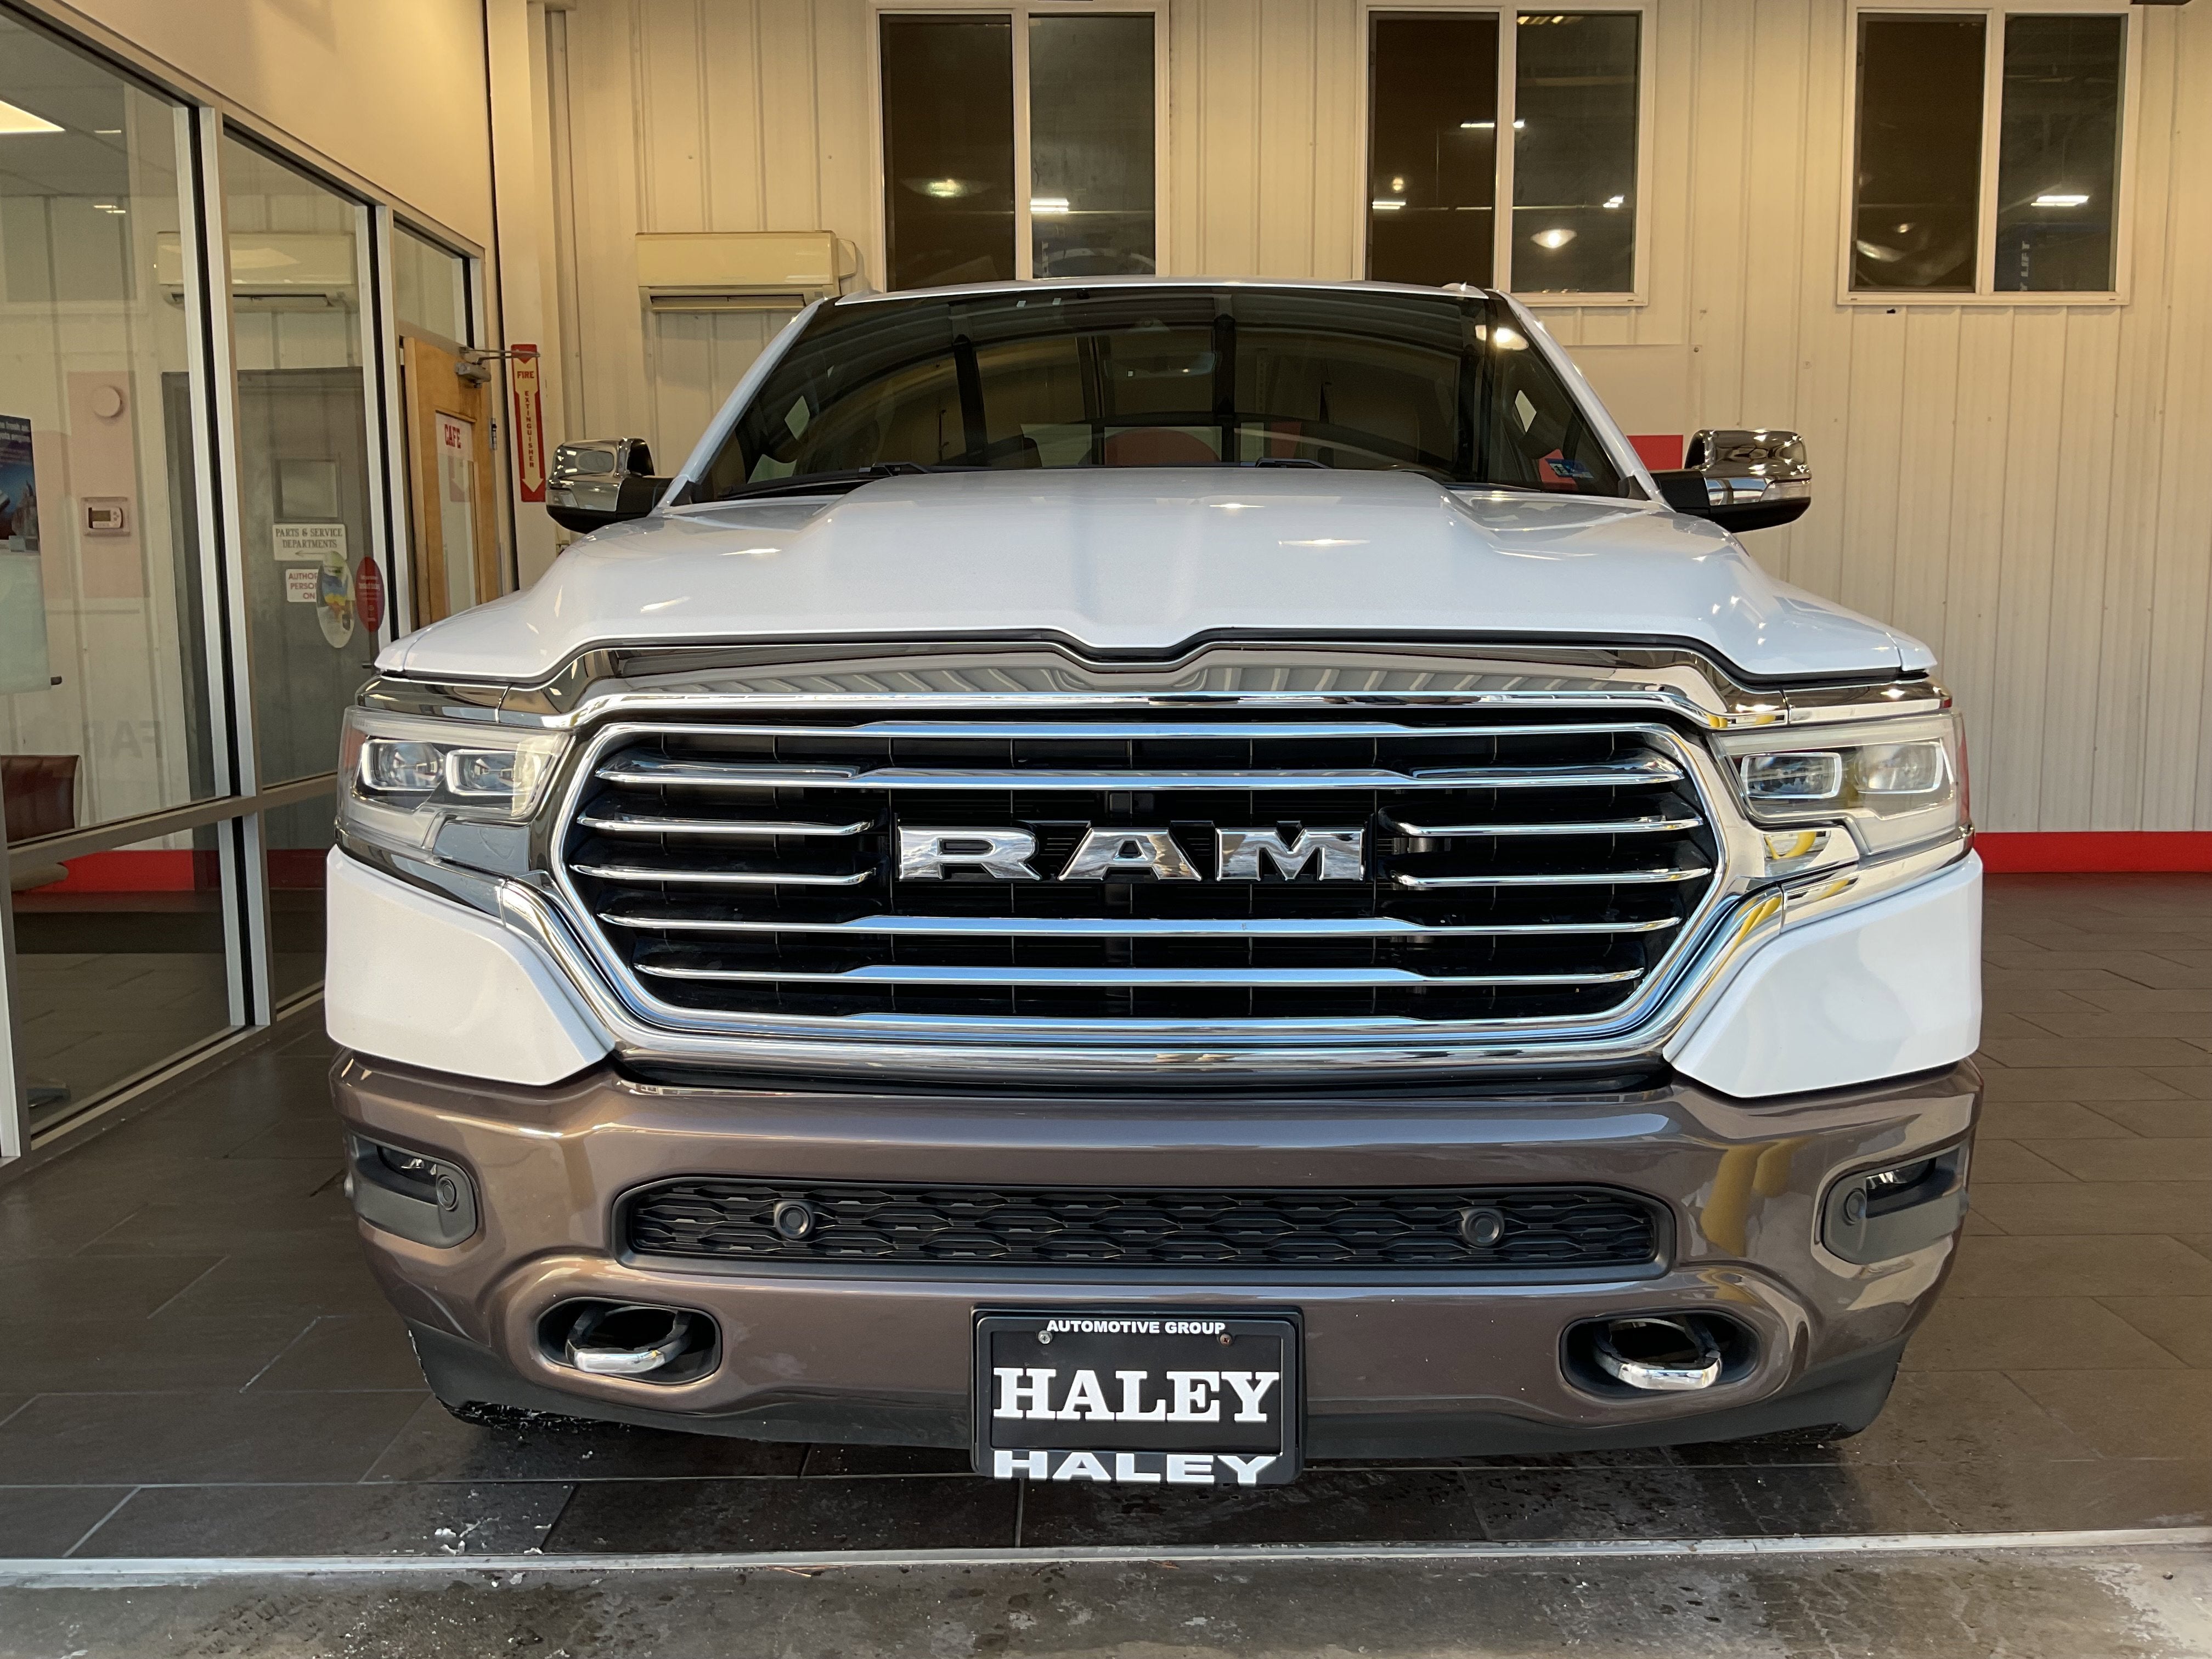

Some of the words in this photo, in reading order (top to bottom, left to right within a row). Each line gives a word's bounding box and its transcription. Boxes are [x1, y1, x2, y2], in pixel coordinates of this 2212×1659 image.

[517, 371, 534, 379] FIRE
[444, 424, 461, 449] CAFE
[524, 391, 534, 468] EXTINGUISHER
[275, 528, 300, 537] PARTS
[302, 528, 308, 537] &
[310, 528, 343, 537] SERVICE
[283, 539, 337, 548] DEPARTMENTS
[898, 826, 1365, 882] RAM
[1047, 1319, 1159, 1334] AUTOMOTIVE
[1165, 1322, 1226, 1335] GROUP
[993, 1368, 1279, 1423] HALEY
[993, 1450, 1277, 1486] HALEY
